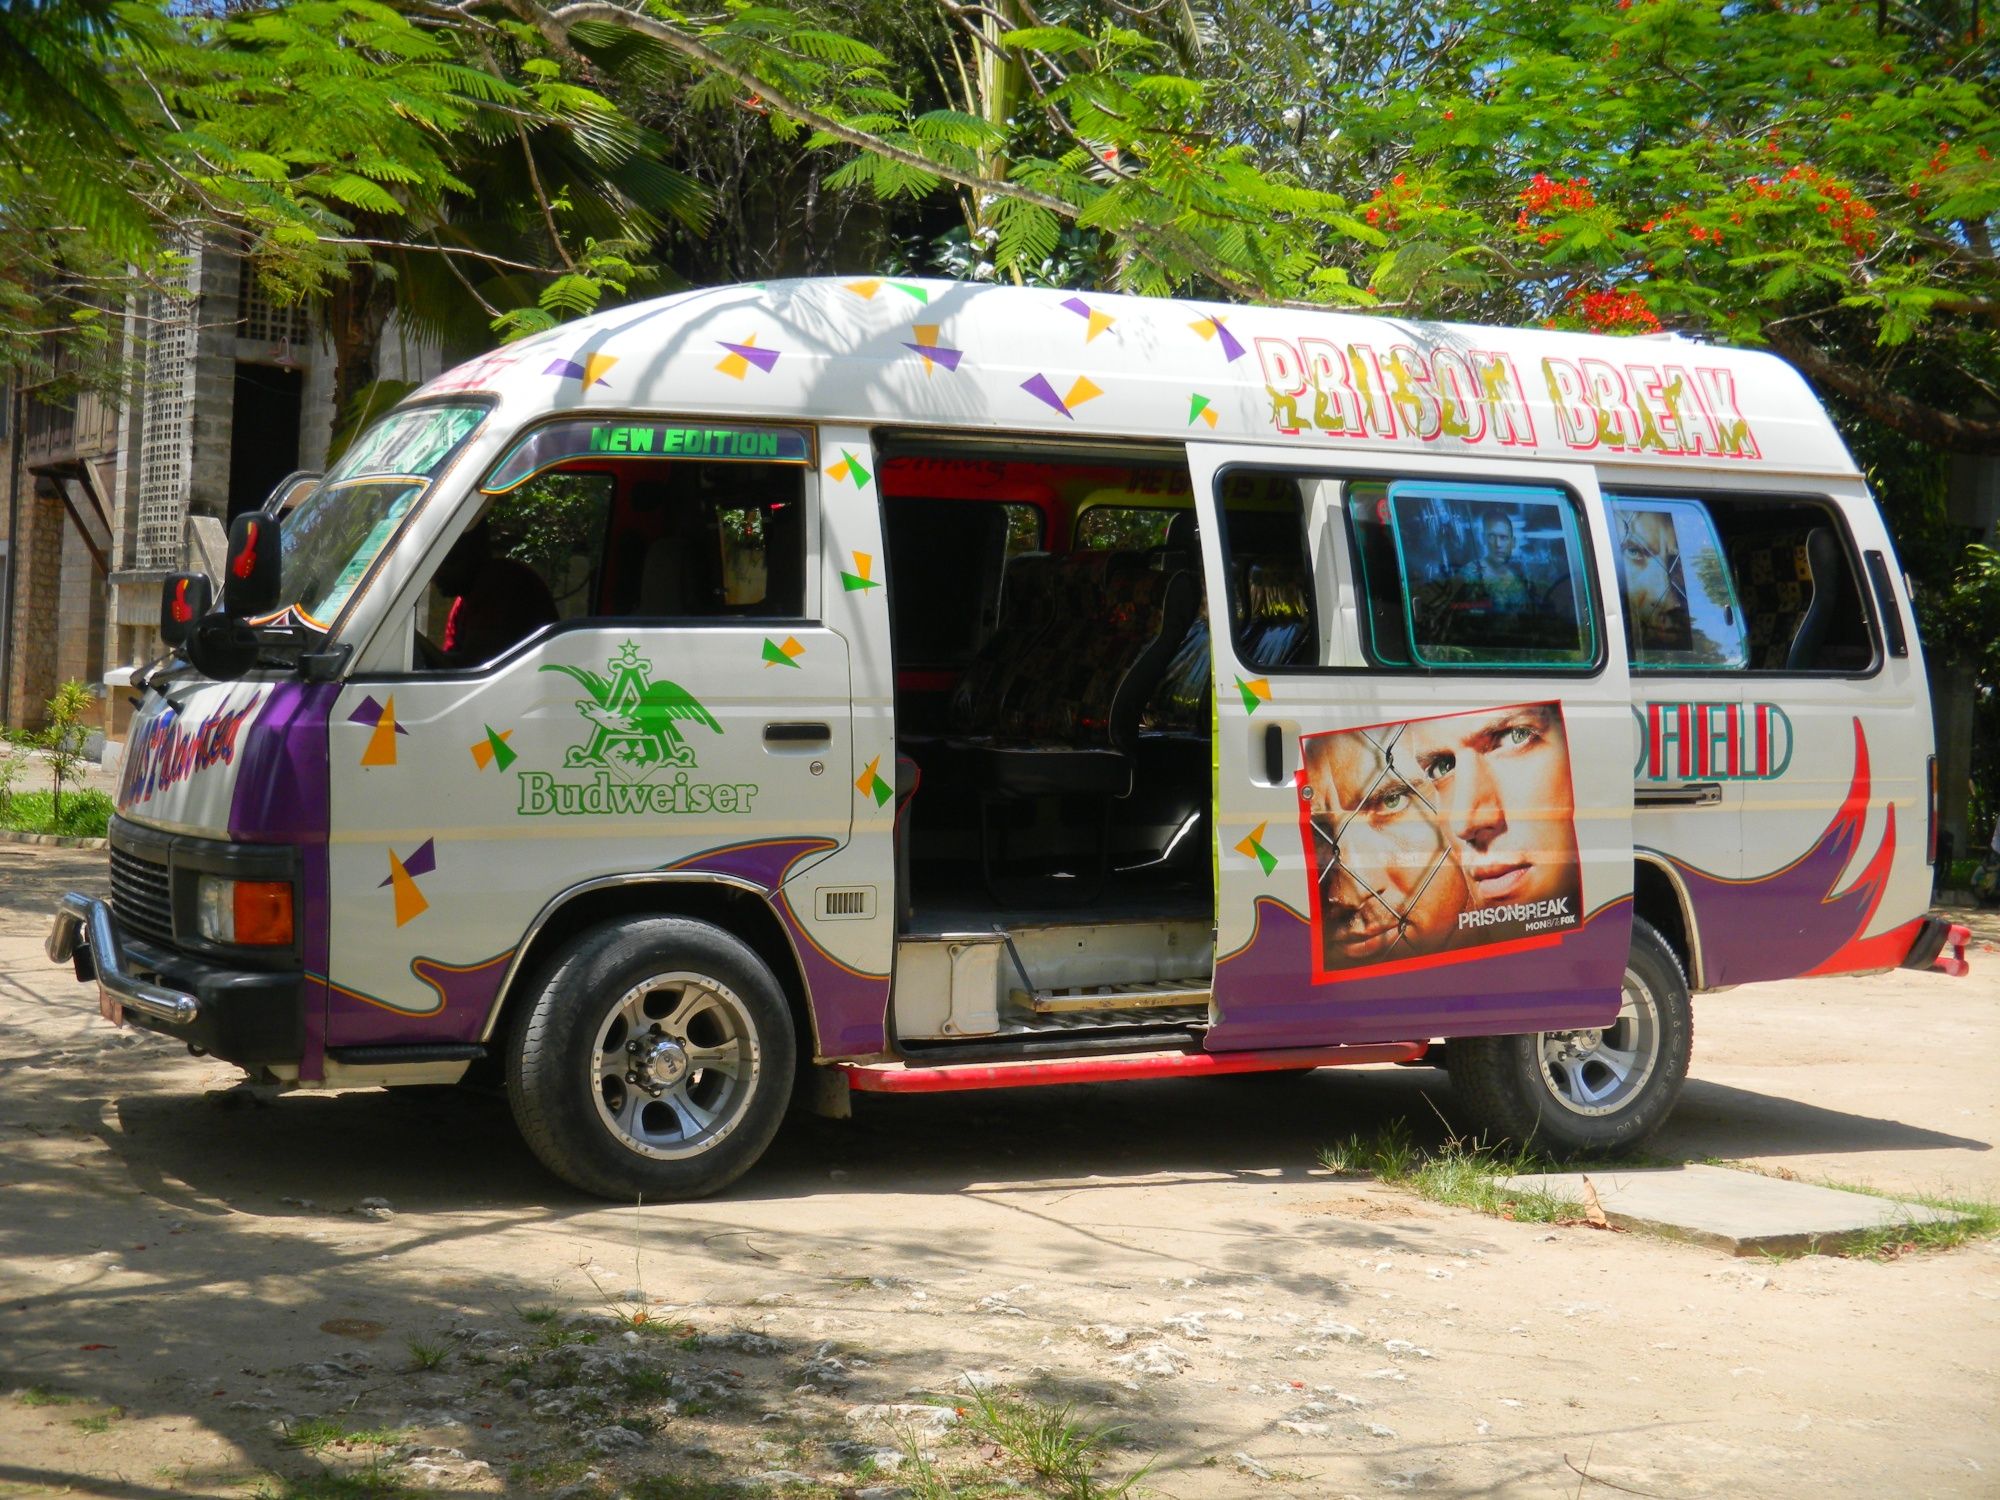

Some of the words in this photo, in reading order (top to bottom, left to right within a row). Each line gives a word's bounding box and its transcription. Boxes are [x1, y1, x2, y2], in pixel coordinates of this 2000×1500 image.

[1254, 337, 1538, 447] PRISON
[1541, 357, 1763, 460] BREAK
[590, 427, 654, 451] NEW
[664, 429, 777, 455] EDITION
[518, 772, 759, 815] Budweiser
